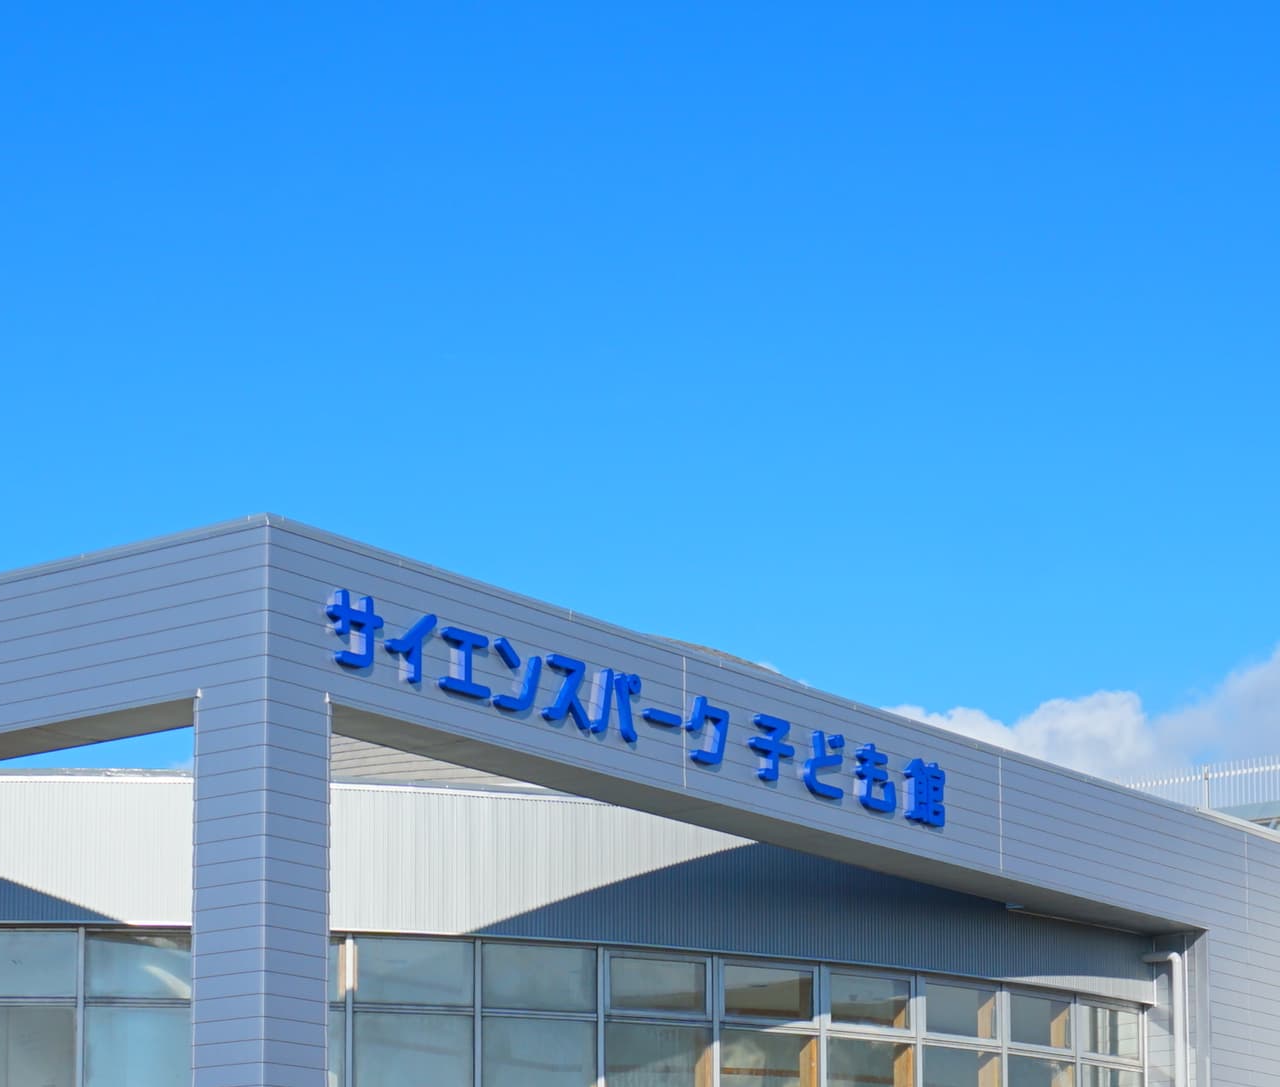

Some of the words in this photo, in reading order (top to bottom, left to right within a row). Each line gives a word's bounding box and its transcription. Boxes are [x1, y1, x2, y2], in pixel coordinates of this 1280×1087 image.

[326, 588, 730, 766] サイエンスパーク
[748, 713, 946, 828] 子ども館
